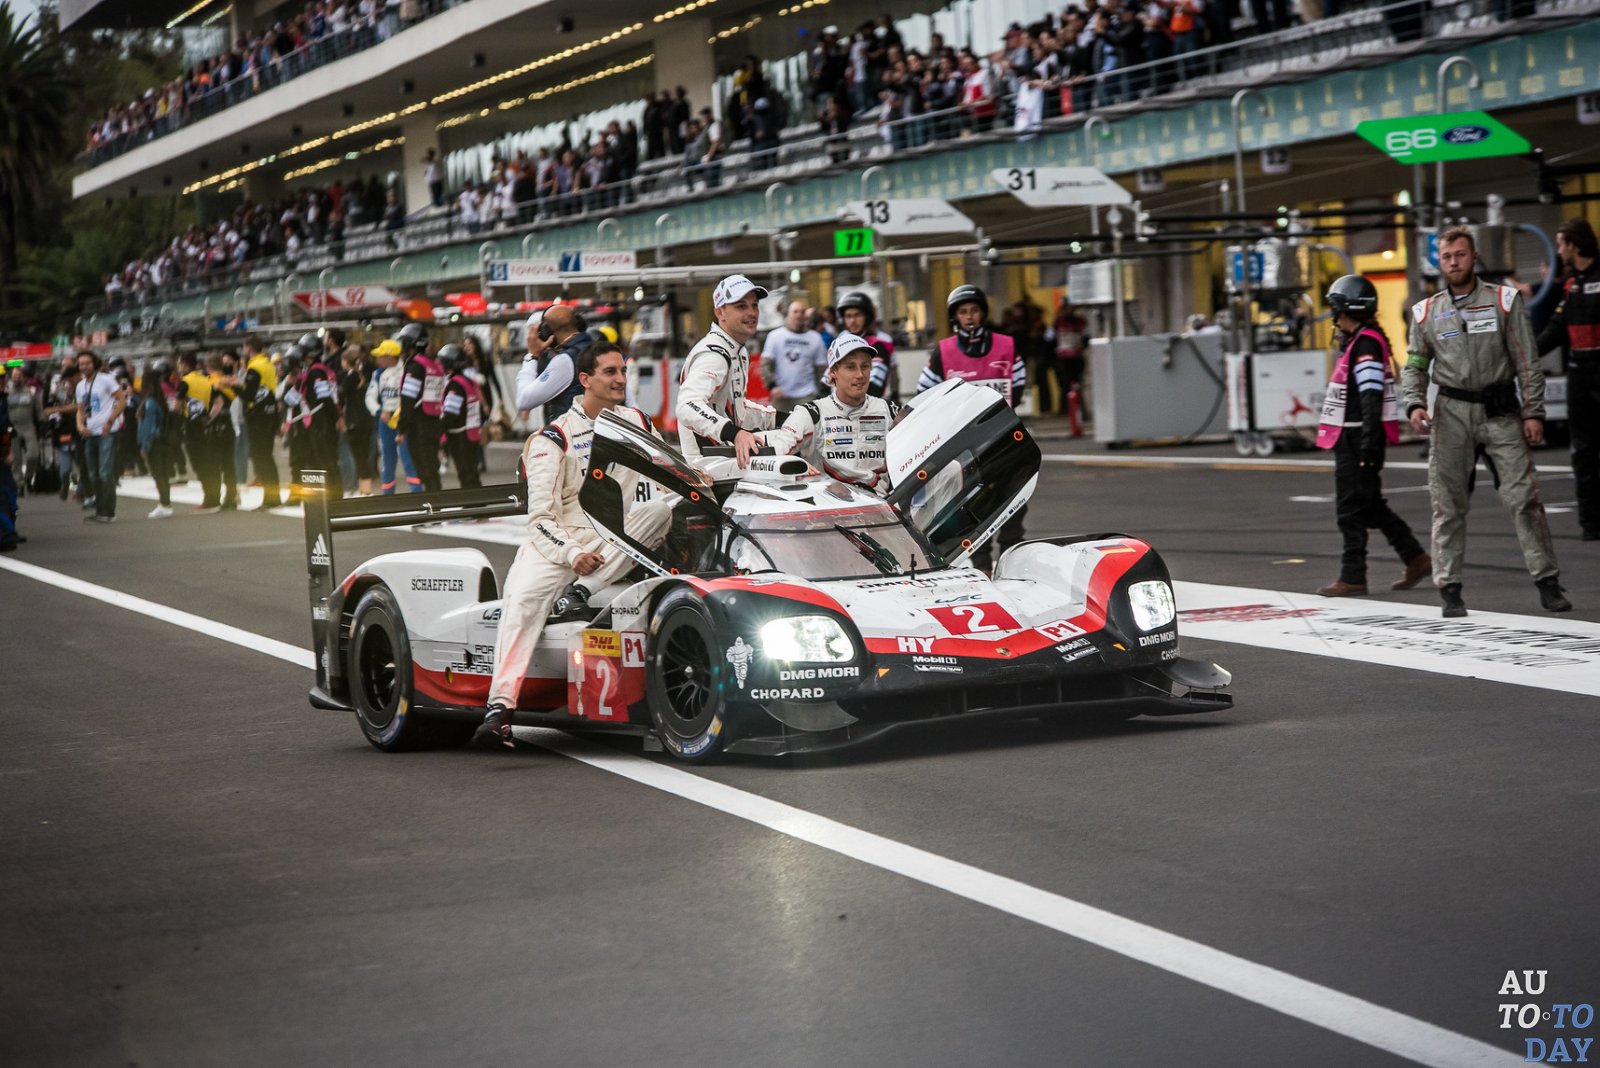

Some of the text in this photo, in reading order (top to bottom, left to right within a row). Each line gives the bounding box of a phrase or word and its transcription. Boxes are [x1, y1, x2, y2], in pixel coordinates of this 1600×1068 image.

[1385, 125, 1483, 151] 66 Ford
[1008, 169, 1037, 191] 31
[864, 201, 889, 223] 13
[844, 232, 863, 250] 77
[510, 264, 557, 276] TOYOTA
[566, 254, 632, 272] 7 TOYOTA
[825, 425, 845, 433] Mobil
[827, 450, 885, 459] DMG MORI
[750, 459, 767, 471] Mobil
[411, 578, 464, 592] SCHAEFFLER
[611, 607, 640, 616] CHOPARD
[951, 605, 1000, 633] 2
[1043, 623, 1078, 638] P1
[588, 635, 614, 650] DHL
[896, 636, 935, 654] HY
[1055, 639, 1081, 653] Mobil
[1139, 634, 1160, 647] DMG
[624, 638, 645, 663] P1
[912, 656, 945, 664] Mobil
[780, 667, 859, 681] DMG MORI
[596, 660, 613, 716] 2
[750, 688, 825, 700] CHOPARD
